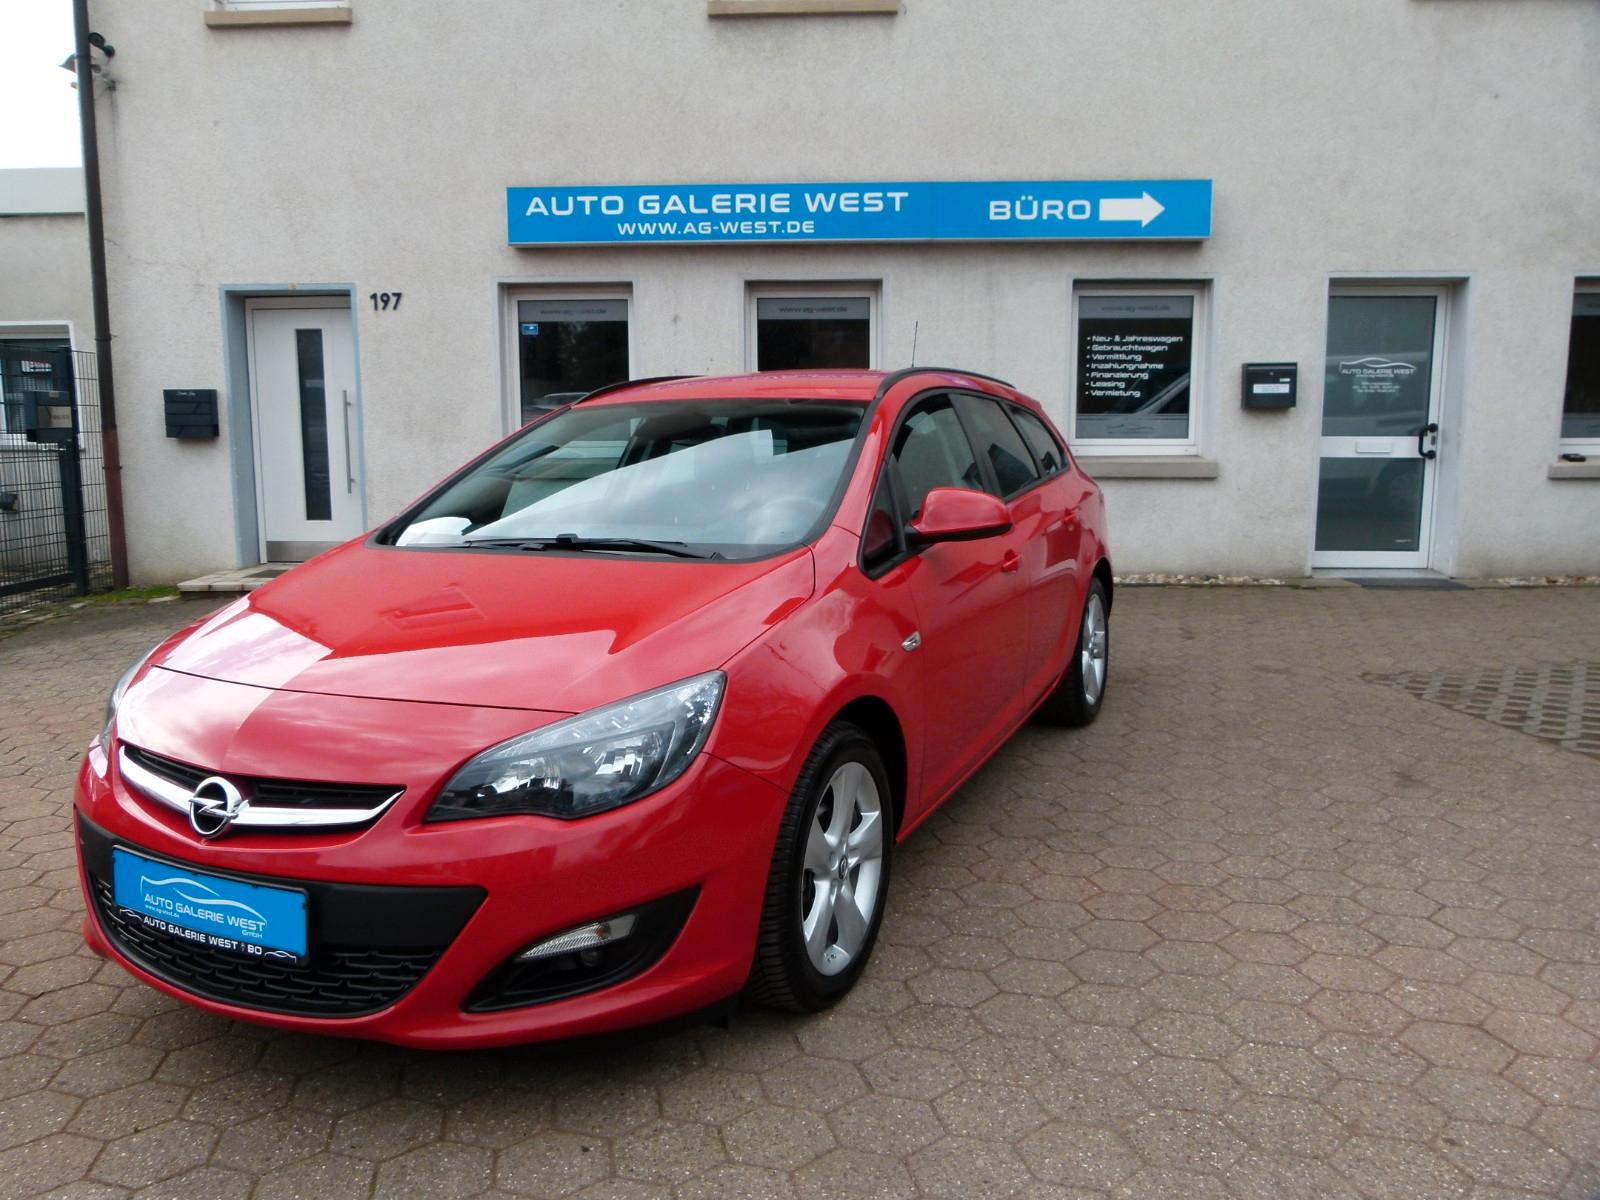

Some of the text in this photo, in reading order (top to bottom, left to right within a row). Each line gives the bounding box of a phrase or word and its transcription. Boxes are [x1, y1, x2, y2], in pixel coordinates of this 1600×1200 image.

[525, 191, 909, 216] AUTO GALERIE WEST
[988, 195, 1092, 220] BÜRO
[617, 220, 816, 235] WWW.AG-WEST.DE
[369, 292, 403, 312] 197
[1122, 335, 1184, 344] Jahreswagen
[1092, 344, 1168, 353] Gebrauchtwagen
[1091, 353, 1142, 361] Vermittlung
[1091, 362, 1164, 371] Inzahlungnahme
[1090, 371, 1149, 380] Finanzierung
[1090, 390, 1141, 398] Vermietung
[144, 893, 266, 932] AUTO GALERIE WEST
[143, 916, 262, 955] AUTO GALERIE WEST BO
[241, 929, 263, 939] GmbH
